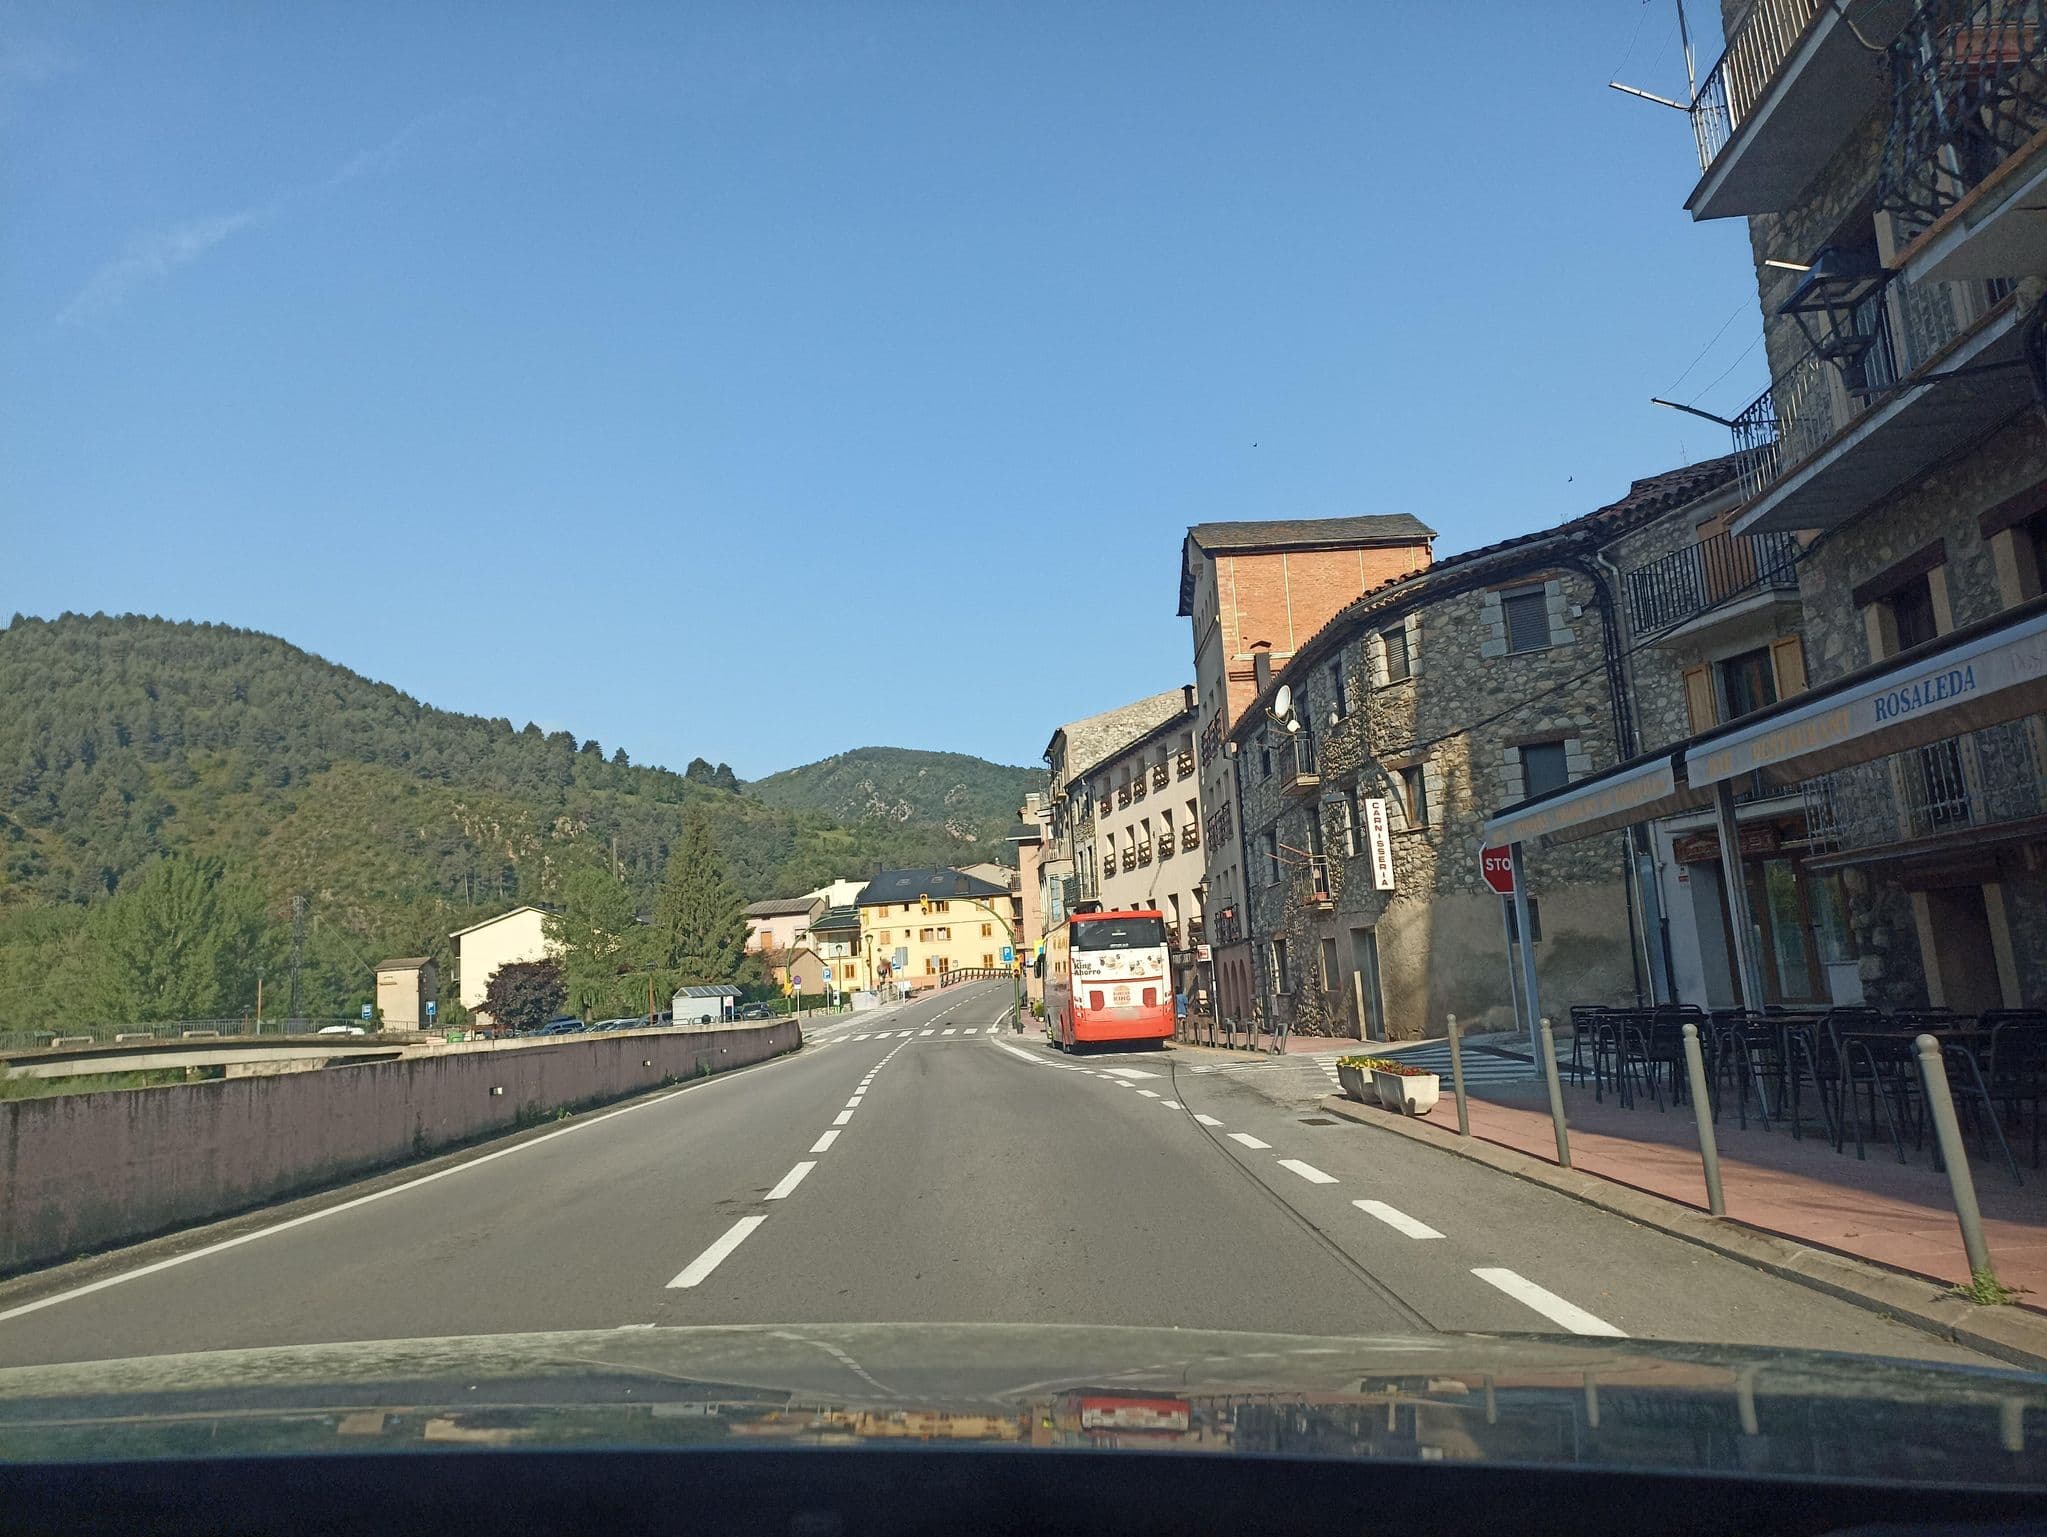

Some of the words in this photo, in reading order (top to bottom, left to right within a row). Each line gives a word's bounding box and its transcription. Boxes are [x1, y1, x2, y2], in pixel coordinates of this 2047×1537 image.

[1875, 666, 1976, 721] ROSALEDA
[1372, 802, 1388, 886] CARNISSERIA
[1486, 858, 1511, 871] STO
[1074, 963, 1092, 971] King
